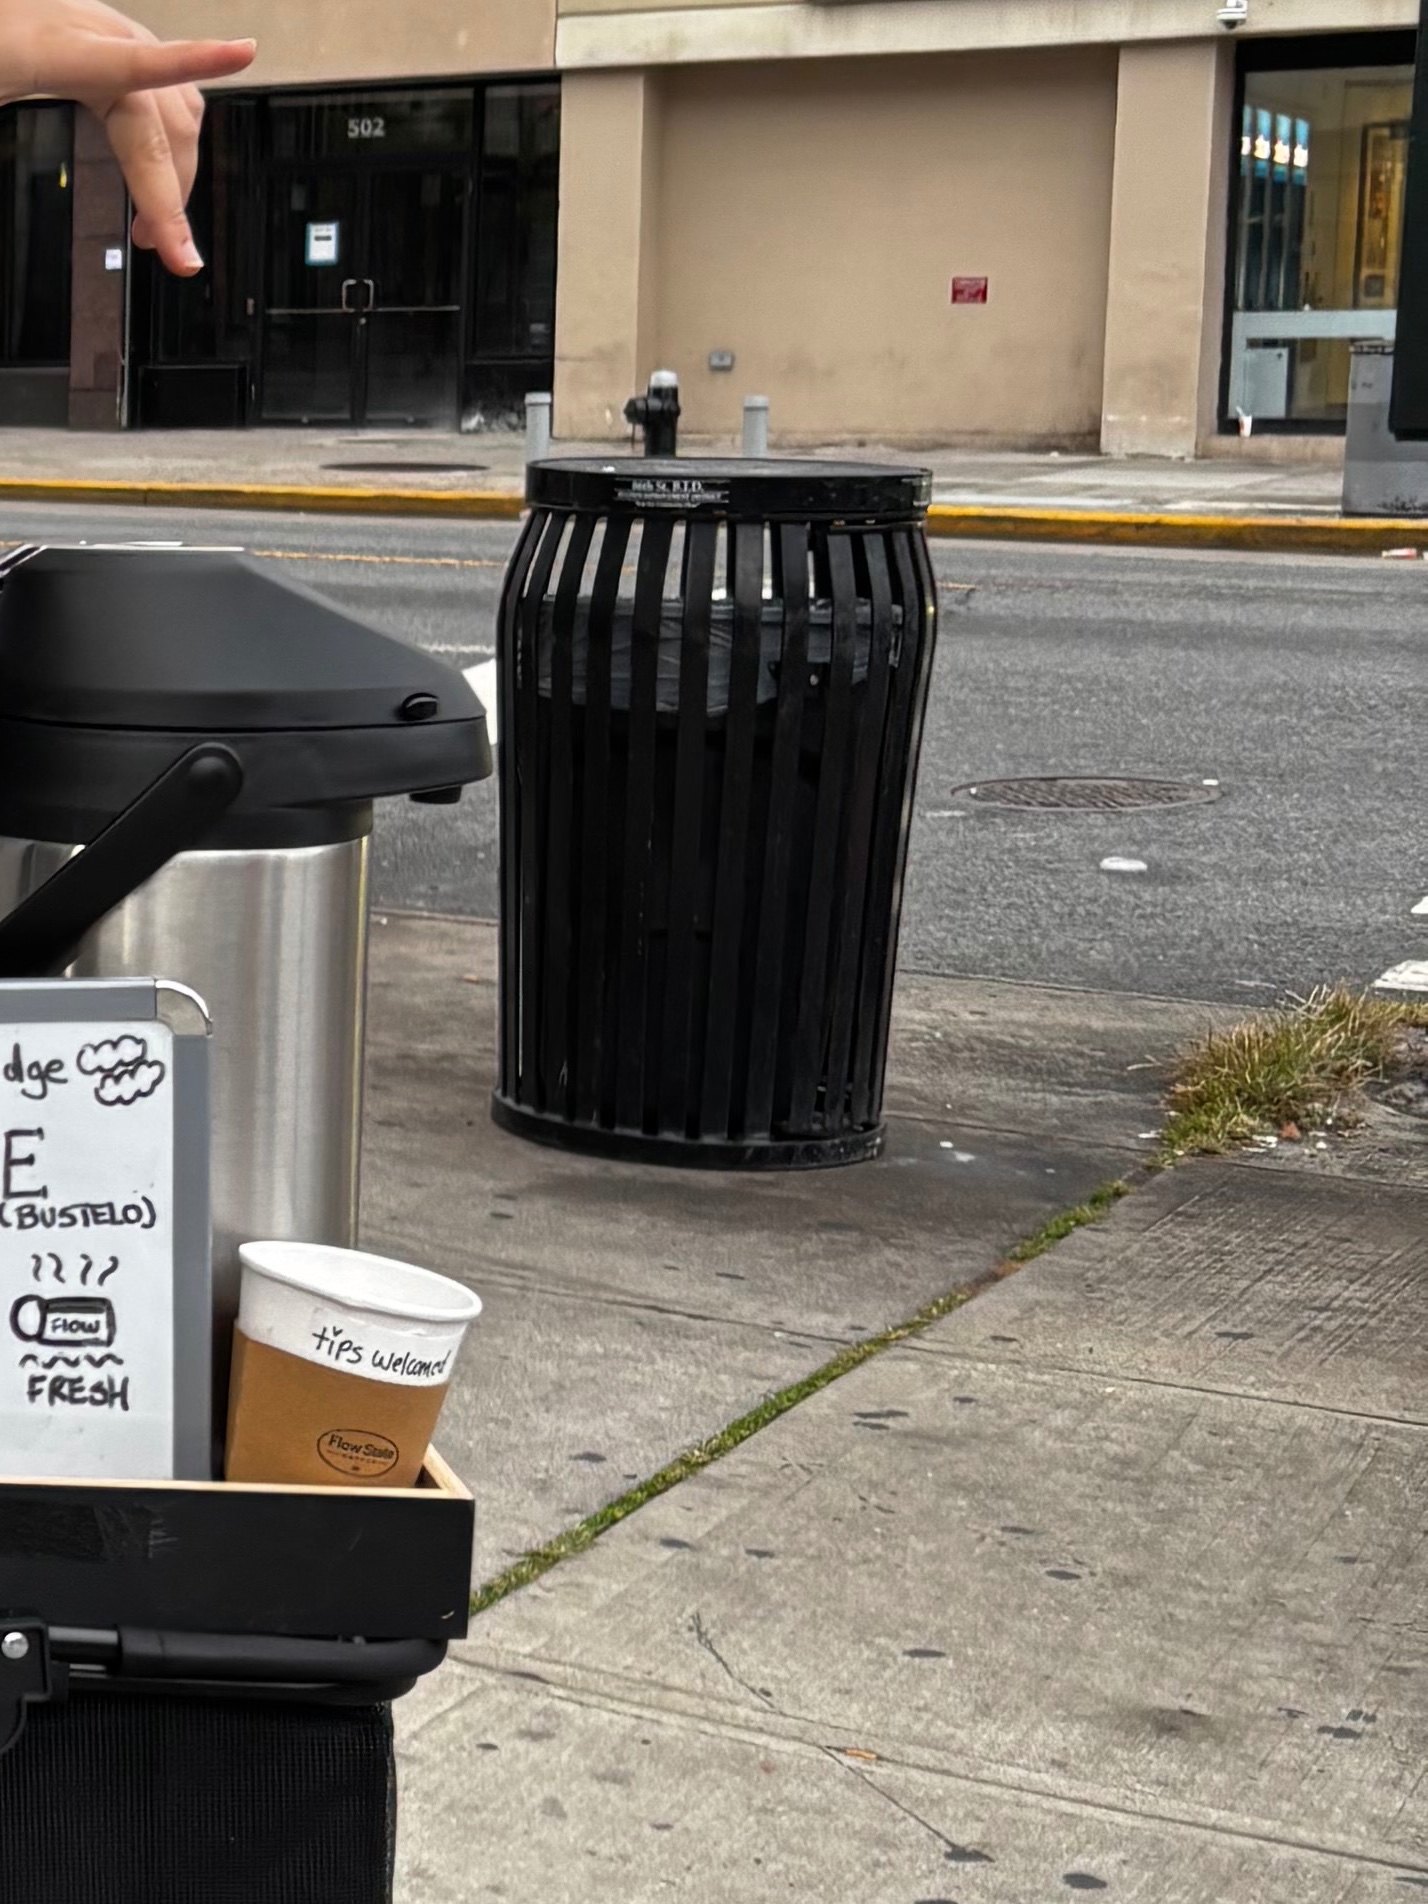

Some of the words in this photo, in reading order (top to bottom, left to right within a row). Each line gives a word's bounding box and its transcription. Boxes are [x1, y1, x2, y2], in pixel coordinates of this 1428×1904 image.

[347, 117, 386, 139] 502
[312, 1325, 363, 1364] tips
[28, 1374, 131, 1412] FRESH
[329, 1434, 363, 1454] Flow
